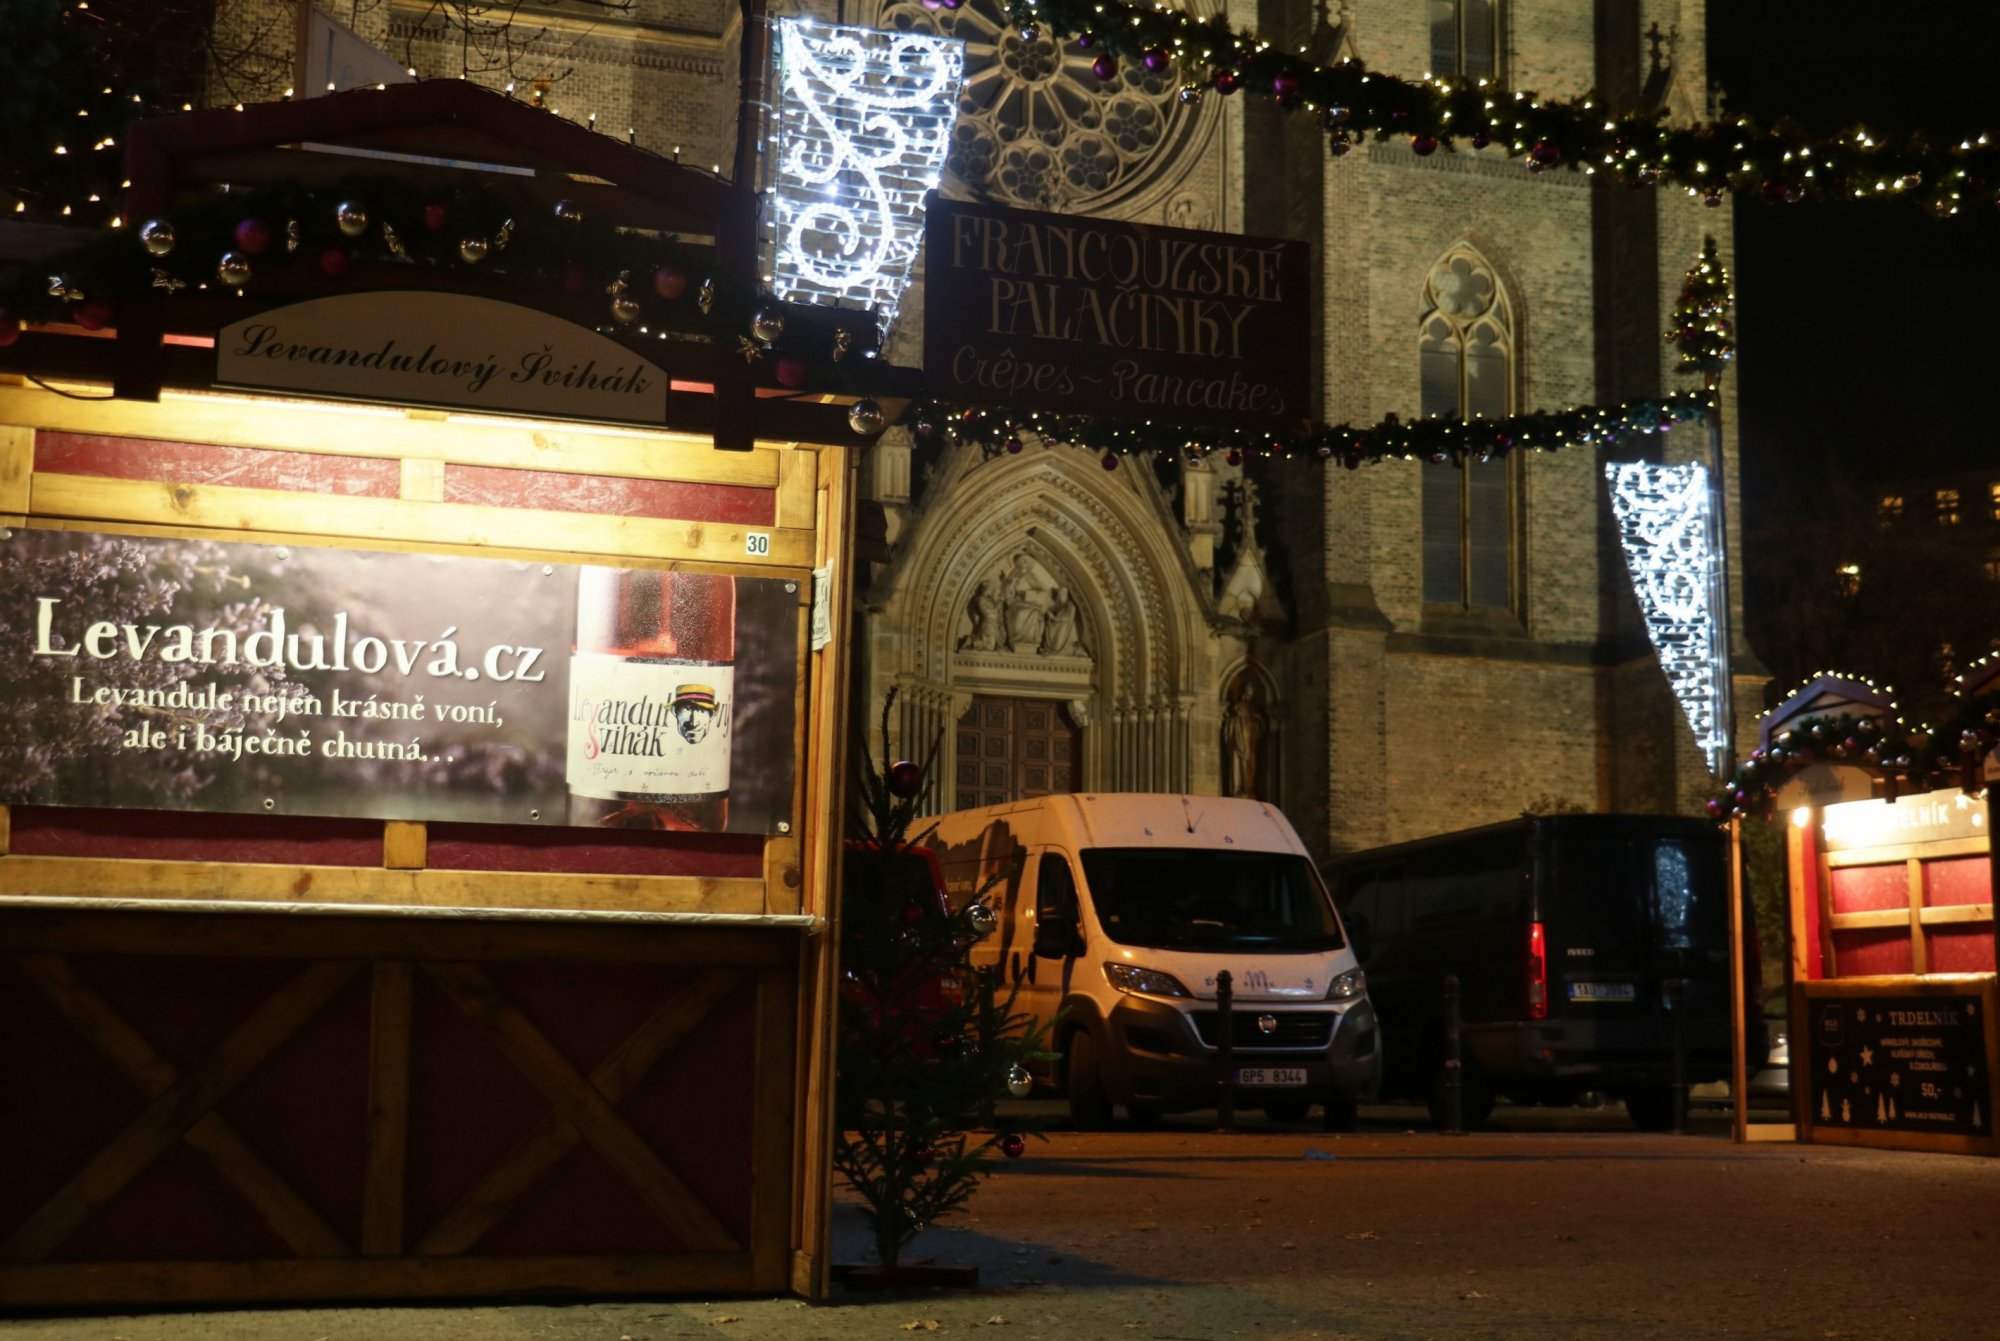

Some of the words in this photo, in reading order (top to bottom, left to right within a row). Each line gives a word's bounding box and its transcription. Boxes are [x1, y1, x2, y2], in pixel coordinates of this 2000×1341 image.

[951, 213, 1286, 302] FRANCOUZSKÉ
[988, 277, 1257, 359] PALAČINKY
[234, 323, 505, 393] Levandulový
[511, 344, 653, 395] Švihák
[953, 345, 1074, 396] Crêpes
[1111, 360, 1285, 415] Pancakes
[747, 535, 769, 554] 30
[34, 597, 545, 682] Levandulová.cz
[72, 676, 234, 712] Levandule
[243, 689, 322, 723] nejen
[332, 688, 425, 721] krásně
[435, 700, 504, 728] voní,
[123, 720, 167, 750] ale
[177, 725, 187, 751] i
[196, 723, 311, 761] báječně
[1888, 1005, 1960, 1026] TRDELNÍK
[1241, 1070, 1265, 1084] 6P5
[1272, 1070, 1303, 1084] 8344
